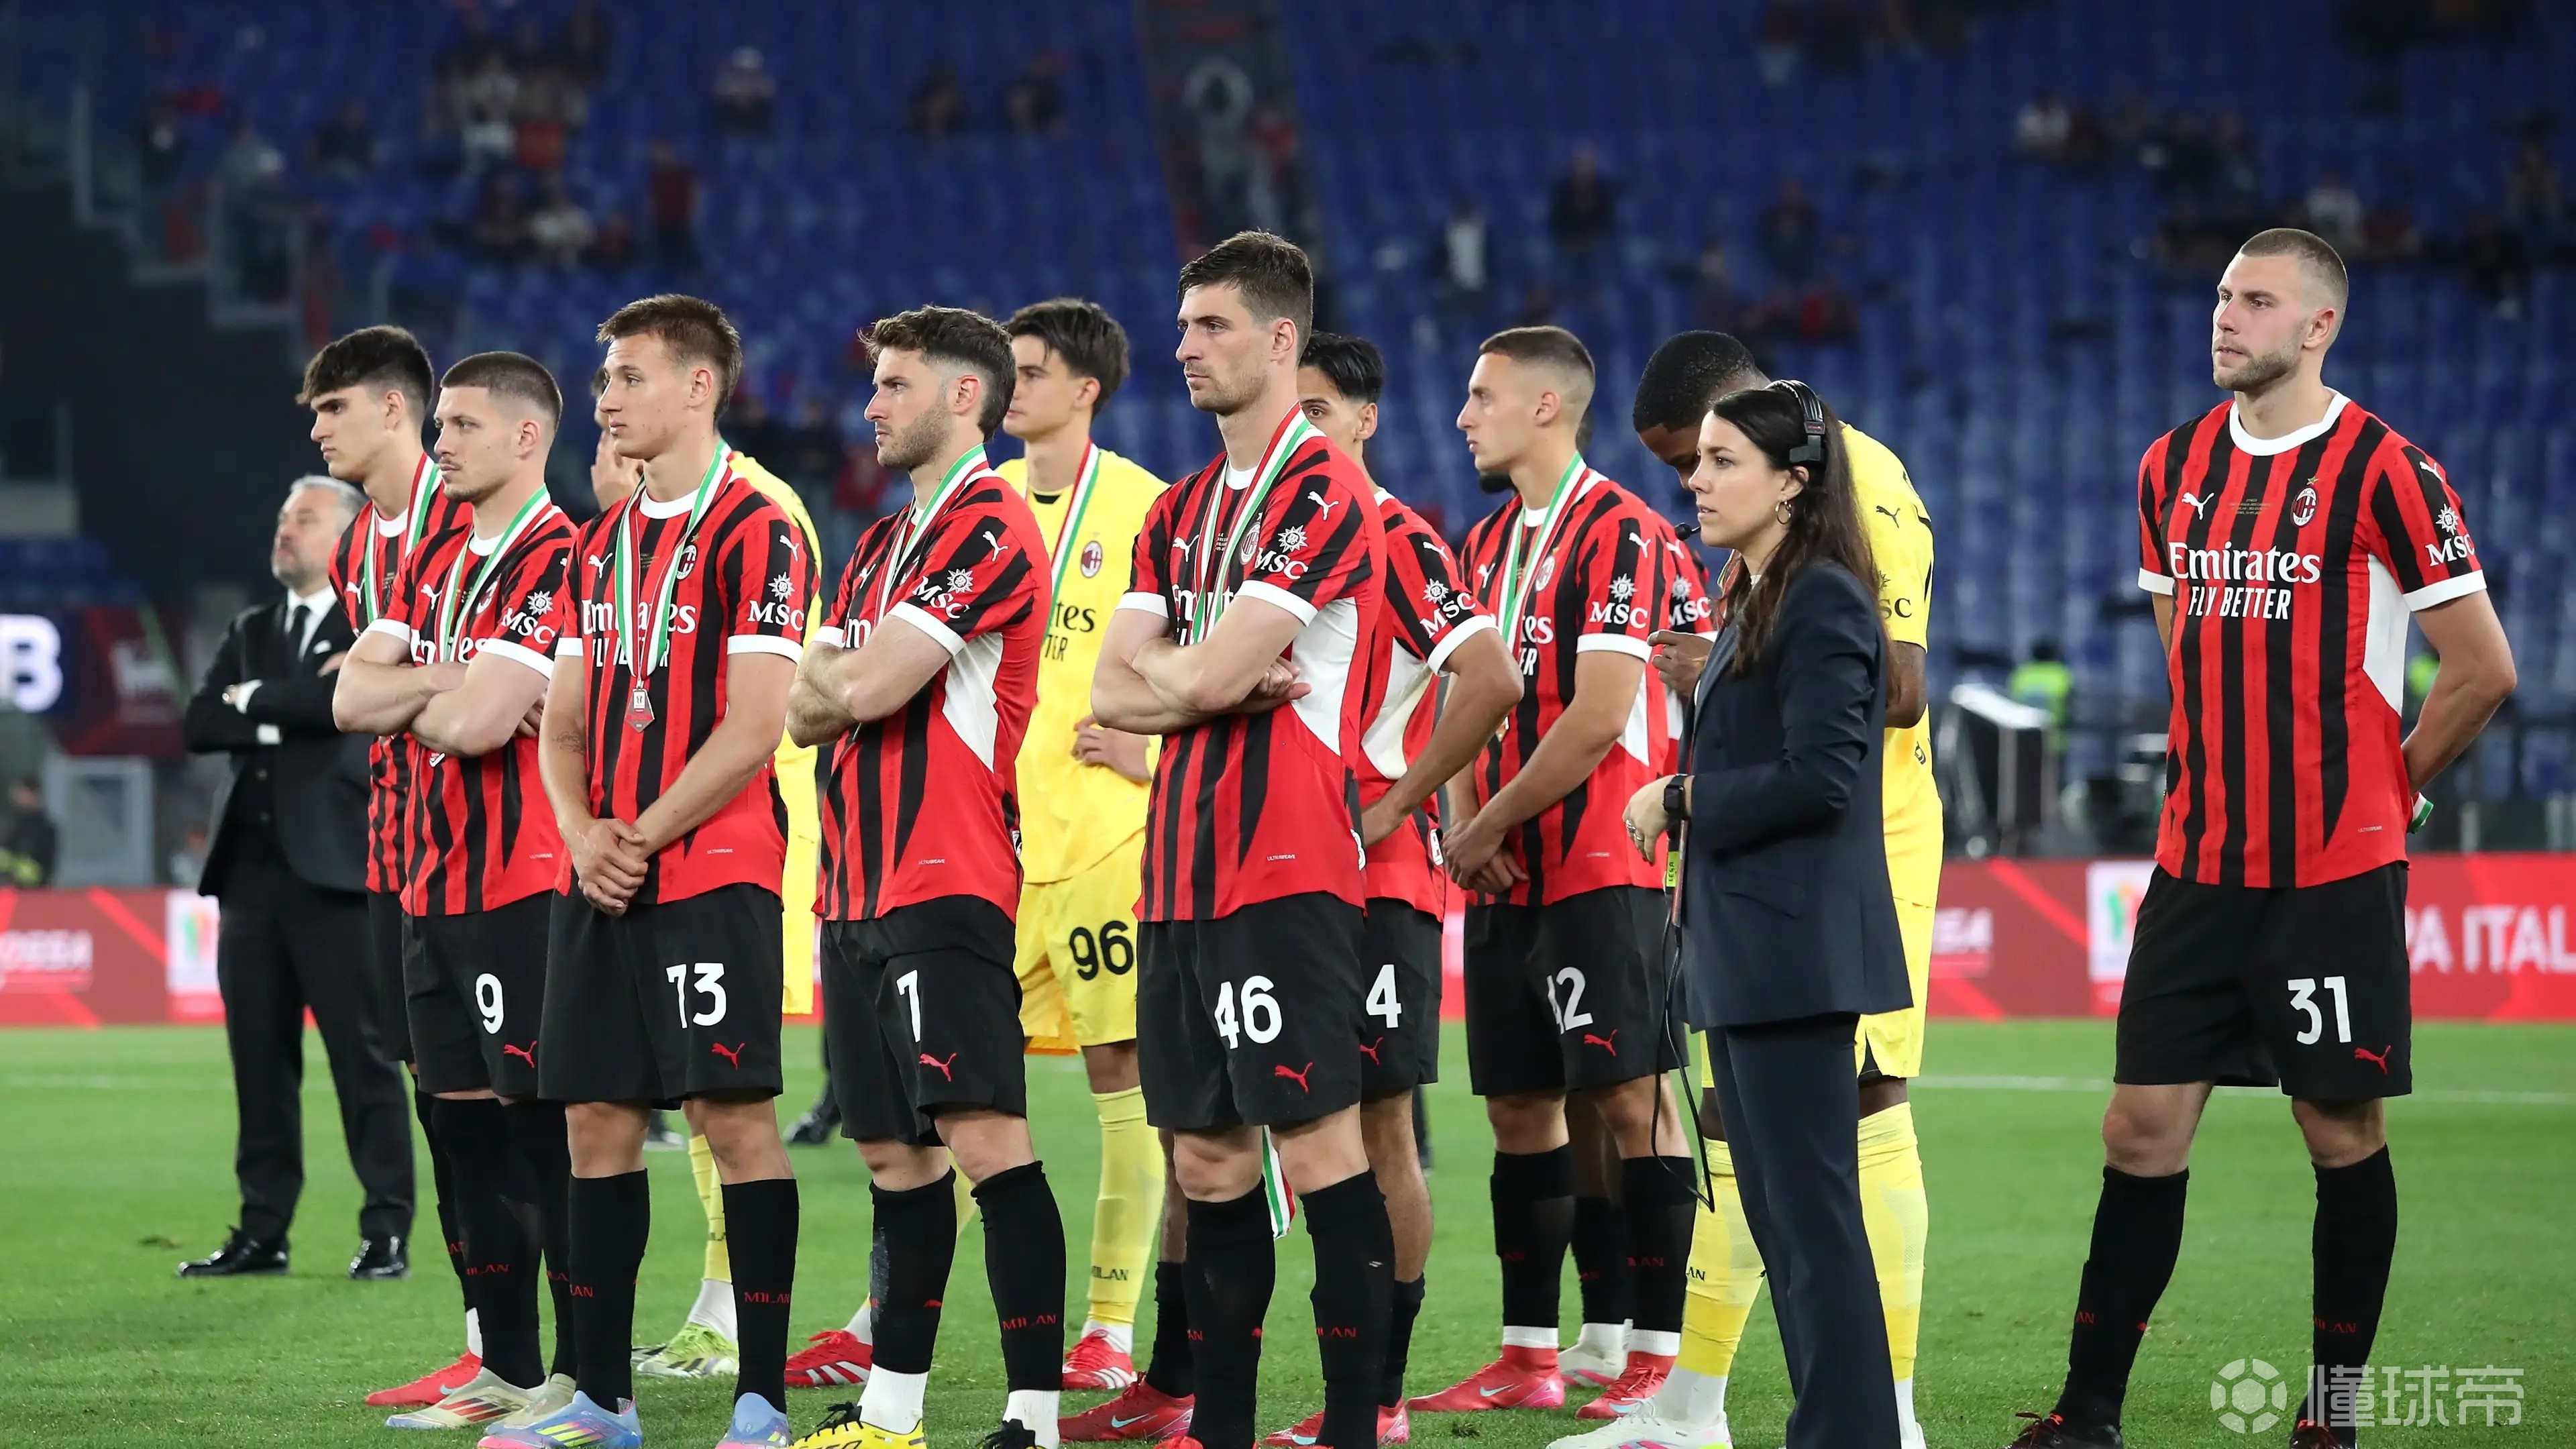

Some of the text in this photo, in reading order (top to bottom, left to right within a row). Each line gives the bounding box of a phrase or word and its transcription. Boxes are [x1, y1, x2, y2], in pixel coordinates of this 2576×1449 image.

[1254, 547, 1309, 579] MSC
[2168, 541, 2320, 584] Emirates
[2425, 534, 2475, 566] MSC
[747, 600, 805, 631] MSC
[912, 576, 970, 619] MSC
[1420, 592, 1476, 638] MSC
[1589, 601, 1648, 629] MSC
[1878, 598, 1912, 619] SC
[2188, 586, 2292, 620] FLY BETTER
[501, 608, 555, 644] MSC
[1069, 920, 1134, 981] 96
[475, 973, 504, 1034] 9
[665, 963, 727, 1028] 73
[1214, 975, 1283, 1049] 46
[1366, 964, 1402, 1028] 4
[2288, 975, 2352, 1045] 31
[744, 1291, 790, 1303] MILAN
[1002, 1315, 1057, 1330] MILAN
